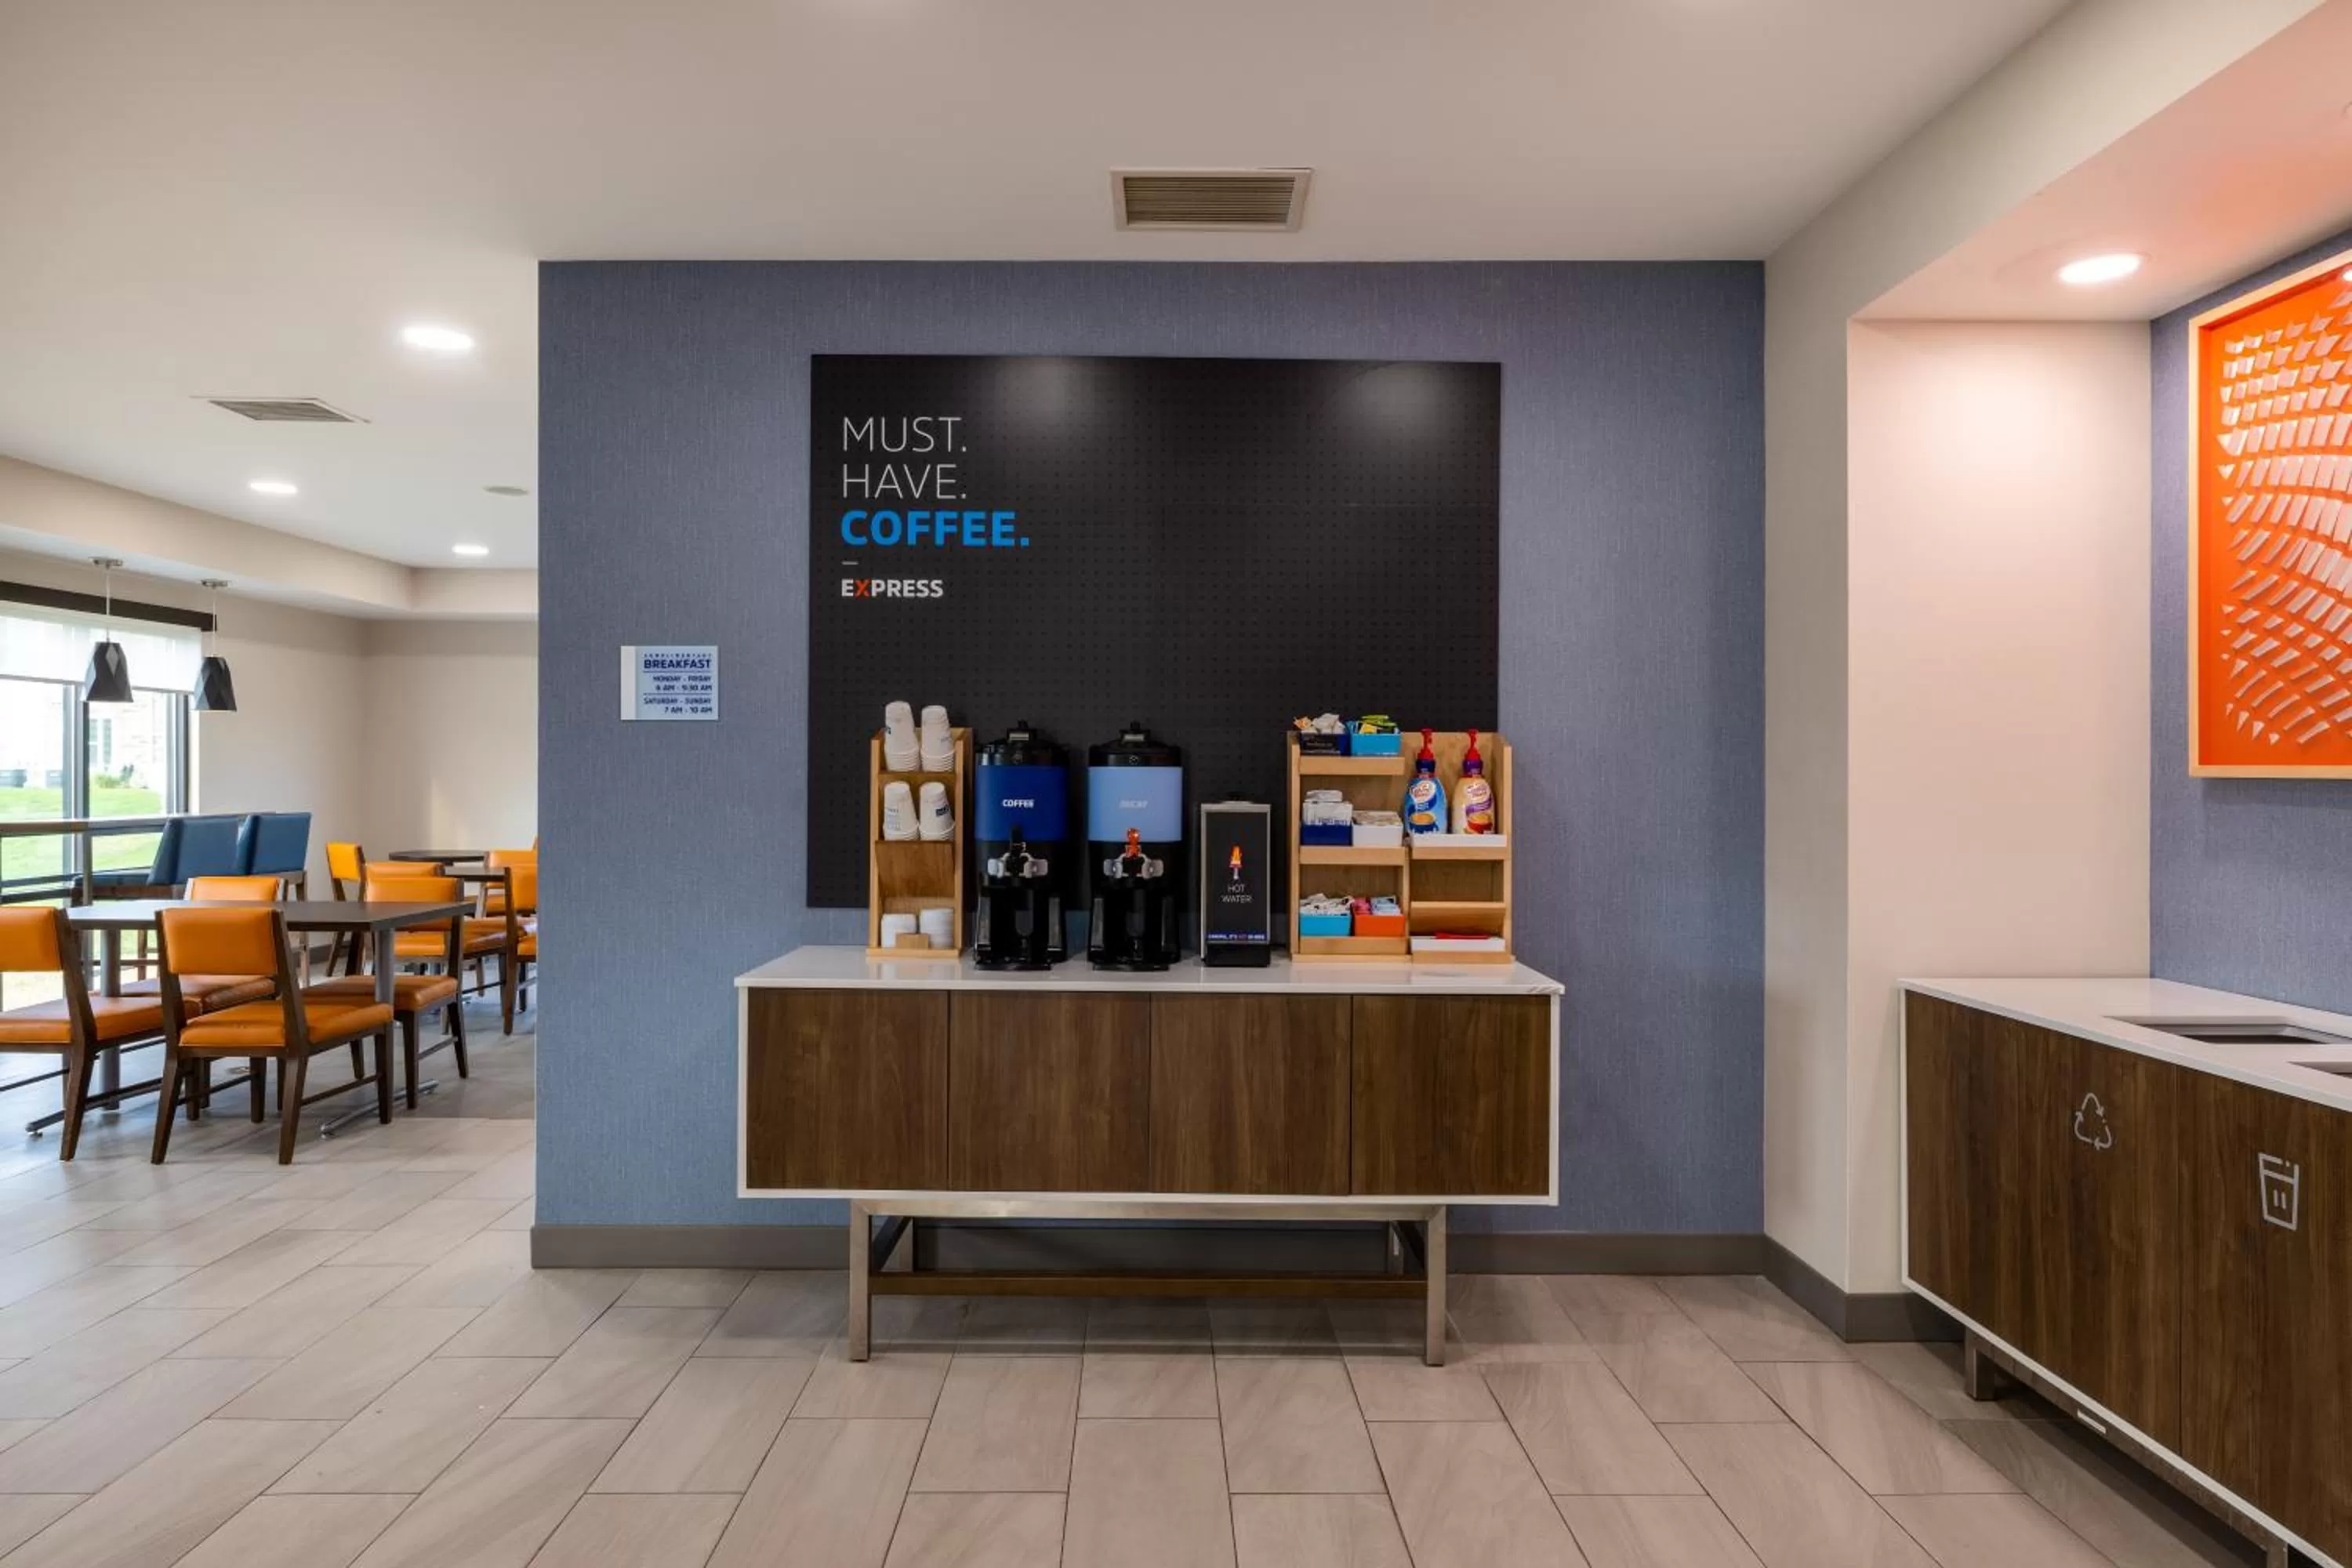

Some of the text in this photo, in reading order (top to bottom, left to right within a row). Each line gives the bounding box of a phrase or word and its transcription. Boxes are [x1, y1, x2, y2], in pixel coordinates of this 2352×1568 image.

[843, 416, 967, 452] MUST.
[843, 463, 967, 499] HAVE.
[840, 510, 1029, 546] COFFEE.
[841, 579, 944, 597] EXPRESS
[644, 659, 711, 669] BREAKFAST
[1003, 799, 1034, 808] COFFEE
[1227, 884, 1245, 893] HOT
[1221, 895, 1252, 903] WATER
